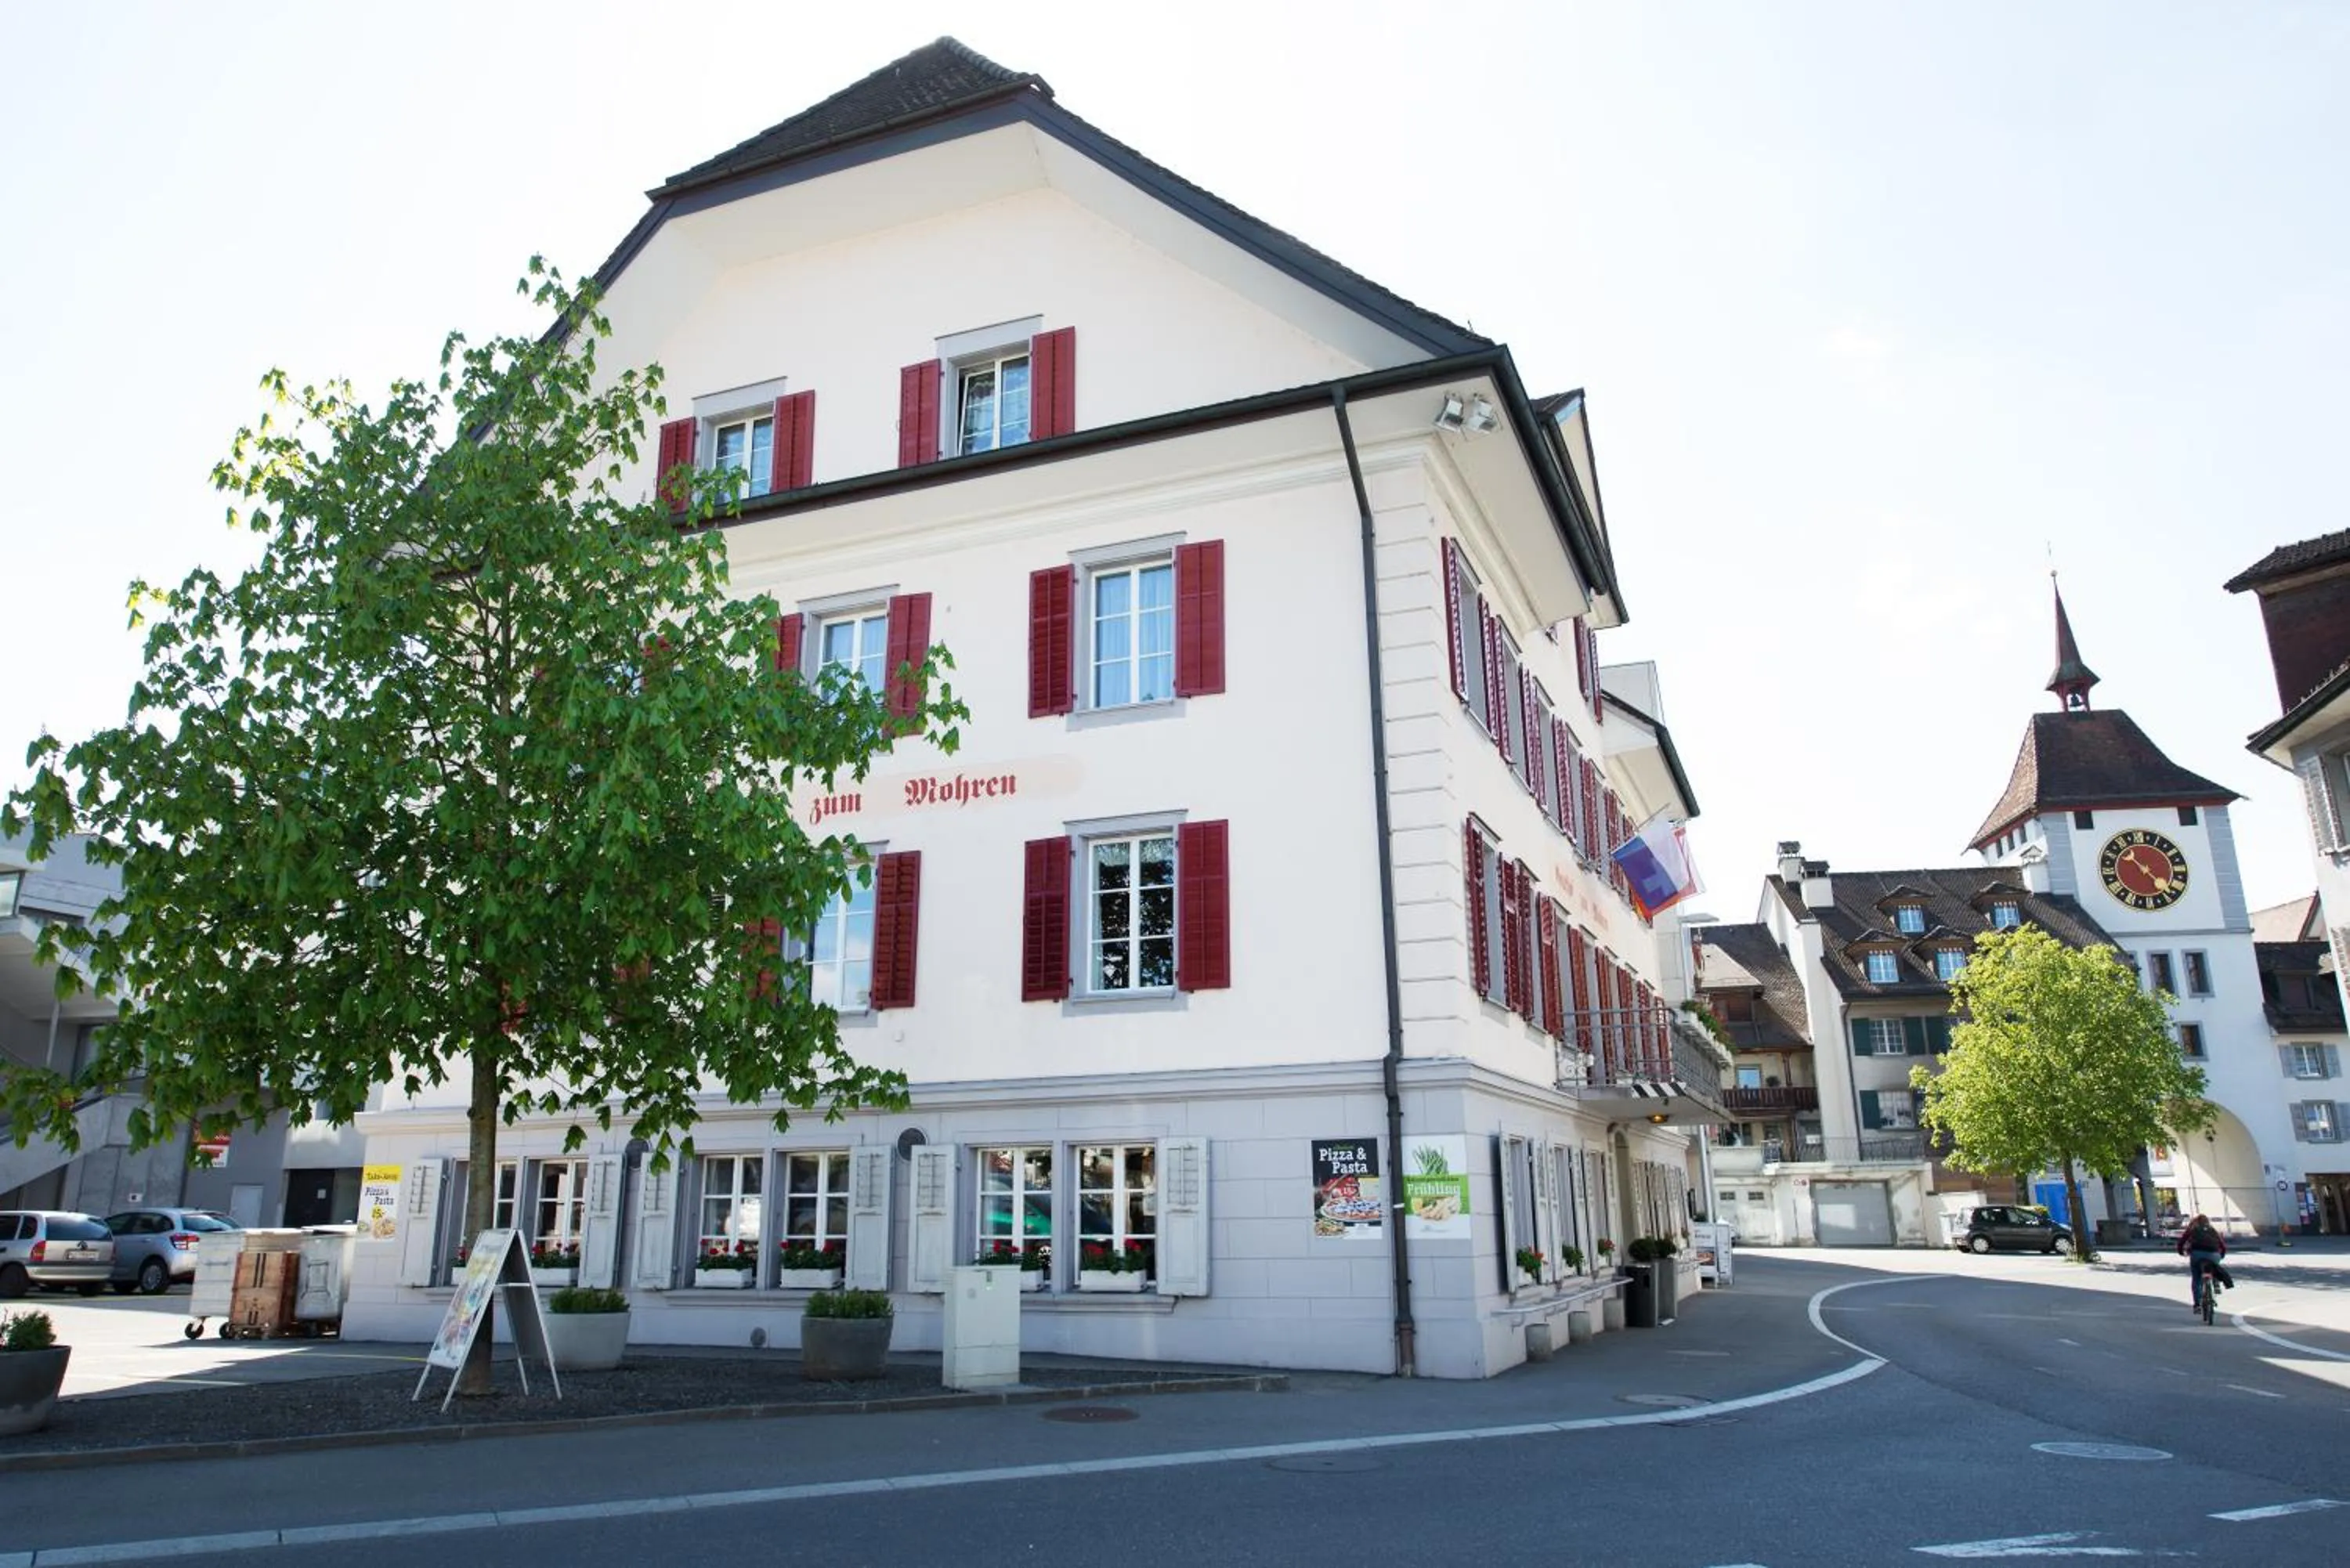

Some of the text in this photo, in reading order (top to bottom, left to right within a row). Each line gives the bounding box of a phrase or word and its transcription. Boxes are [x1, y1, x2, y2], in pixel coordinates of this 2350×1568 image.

[809, 773, 1016, 825] zum Mohren
[1319, 1147, 1354, 1162] Pizza
[1356, 1147, 1367, 1161] &
[1332, 1161, 1368, 1174] Pasta
[374, 1196, 394, 1206] Pasta
